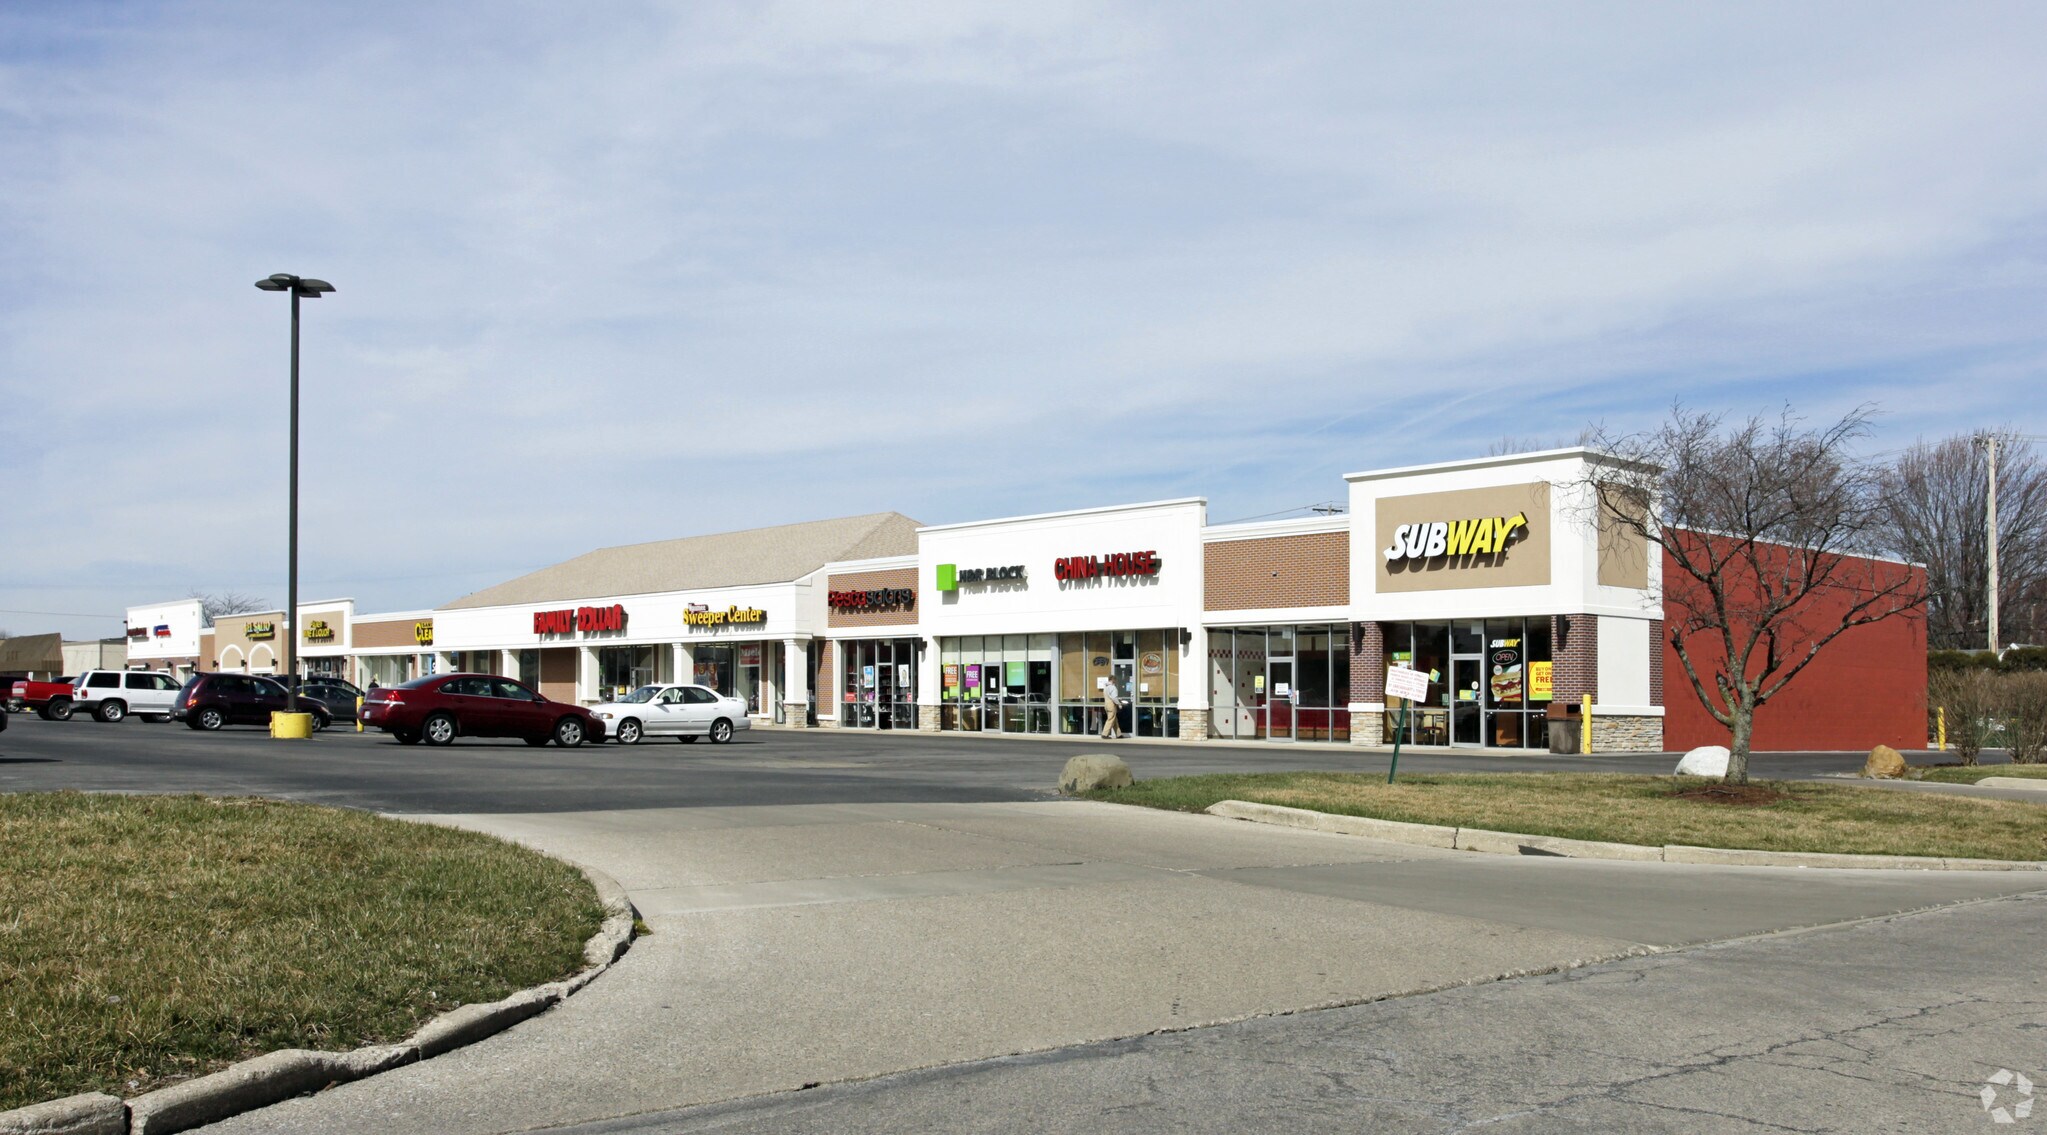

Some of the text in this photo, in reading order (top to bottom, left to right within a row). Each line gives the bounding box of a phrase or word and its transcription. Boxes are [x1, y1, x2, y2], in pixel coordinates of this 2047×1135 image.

[1383, 512, 1527, 561] SUBWAY
[959, 565, 1025, 583] H&R BLOCK
[1054, 550, 1157, 580] CHINA HOUSE
[534, 604, 625, 634] FAMILY DOLLAR
[683, 608, 725, 628] Sweeper
[728, 605, 762, 623] Center
[1490, 638, 1521, 648] SUBWAY
[1495, 653, 1515, 661] OPEN
[945, 666, 958, 675] FREE
[966, 671, 979, 679] FREE
